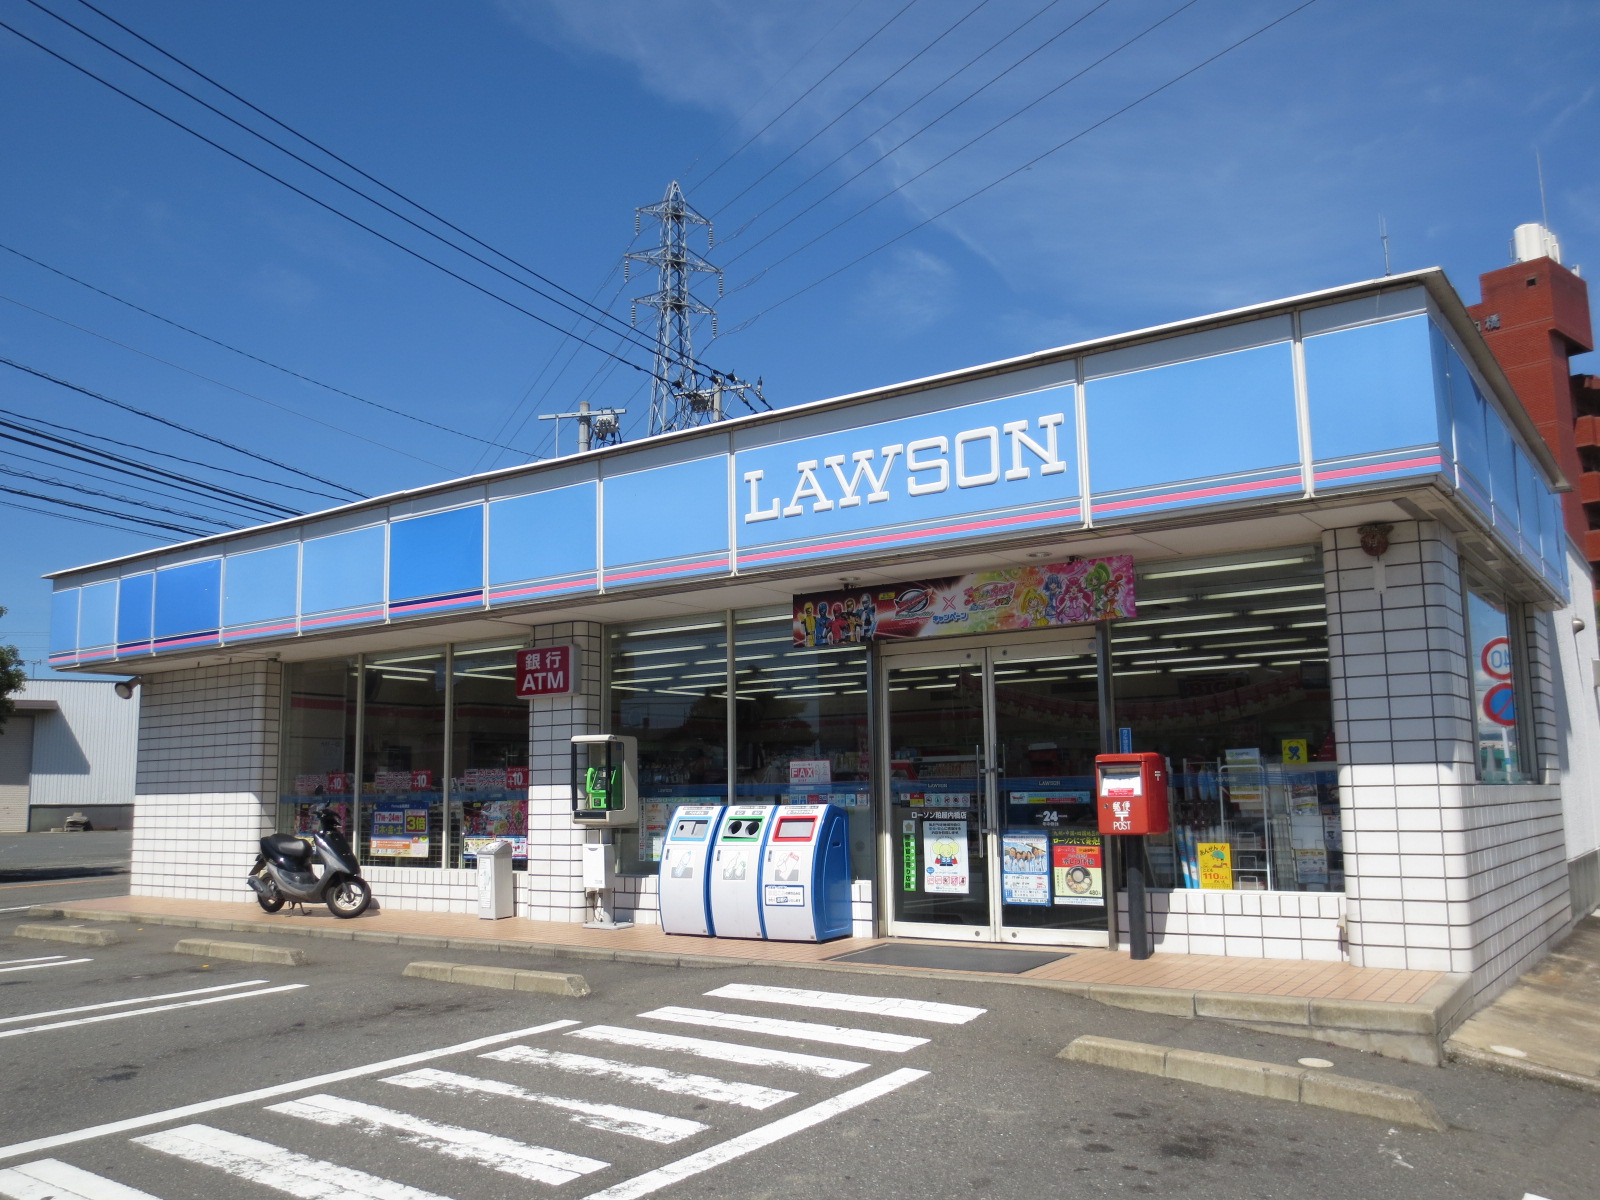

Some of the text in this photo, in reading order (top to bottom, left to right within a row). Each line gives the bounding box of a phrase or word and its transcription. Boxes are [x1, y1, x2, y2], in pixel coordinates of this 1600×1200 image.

[744, 413, 1067, 524] LAWSON
[932, 612, 968, 624] キャンペーン
[525, 651, 562, 671] 銀行
[522, 671, 564, 692] ATM
[792, 768, 814, 778] FAX
[1112, 800, 1131, 812] 郵便
[1043, 810, 1058, 822] 24
[407, 816, 426, 831] 3倍
[1113, 821, 1131, 831] POST
